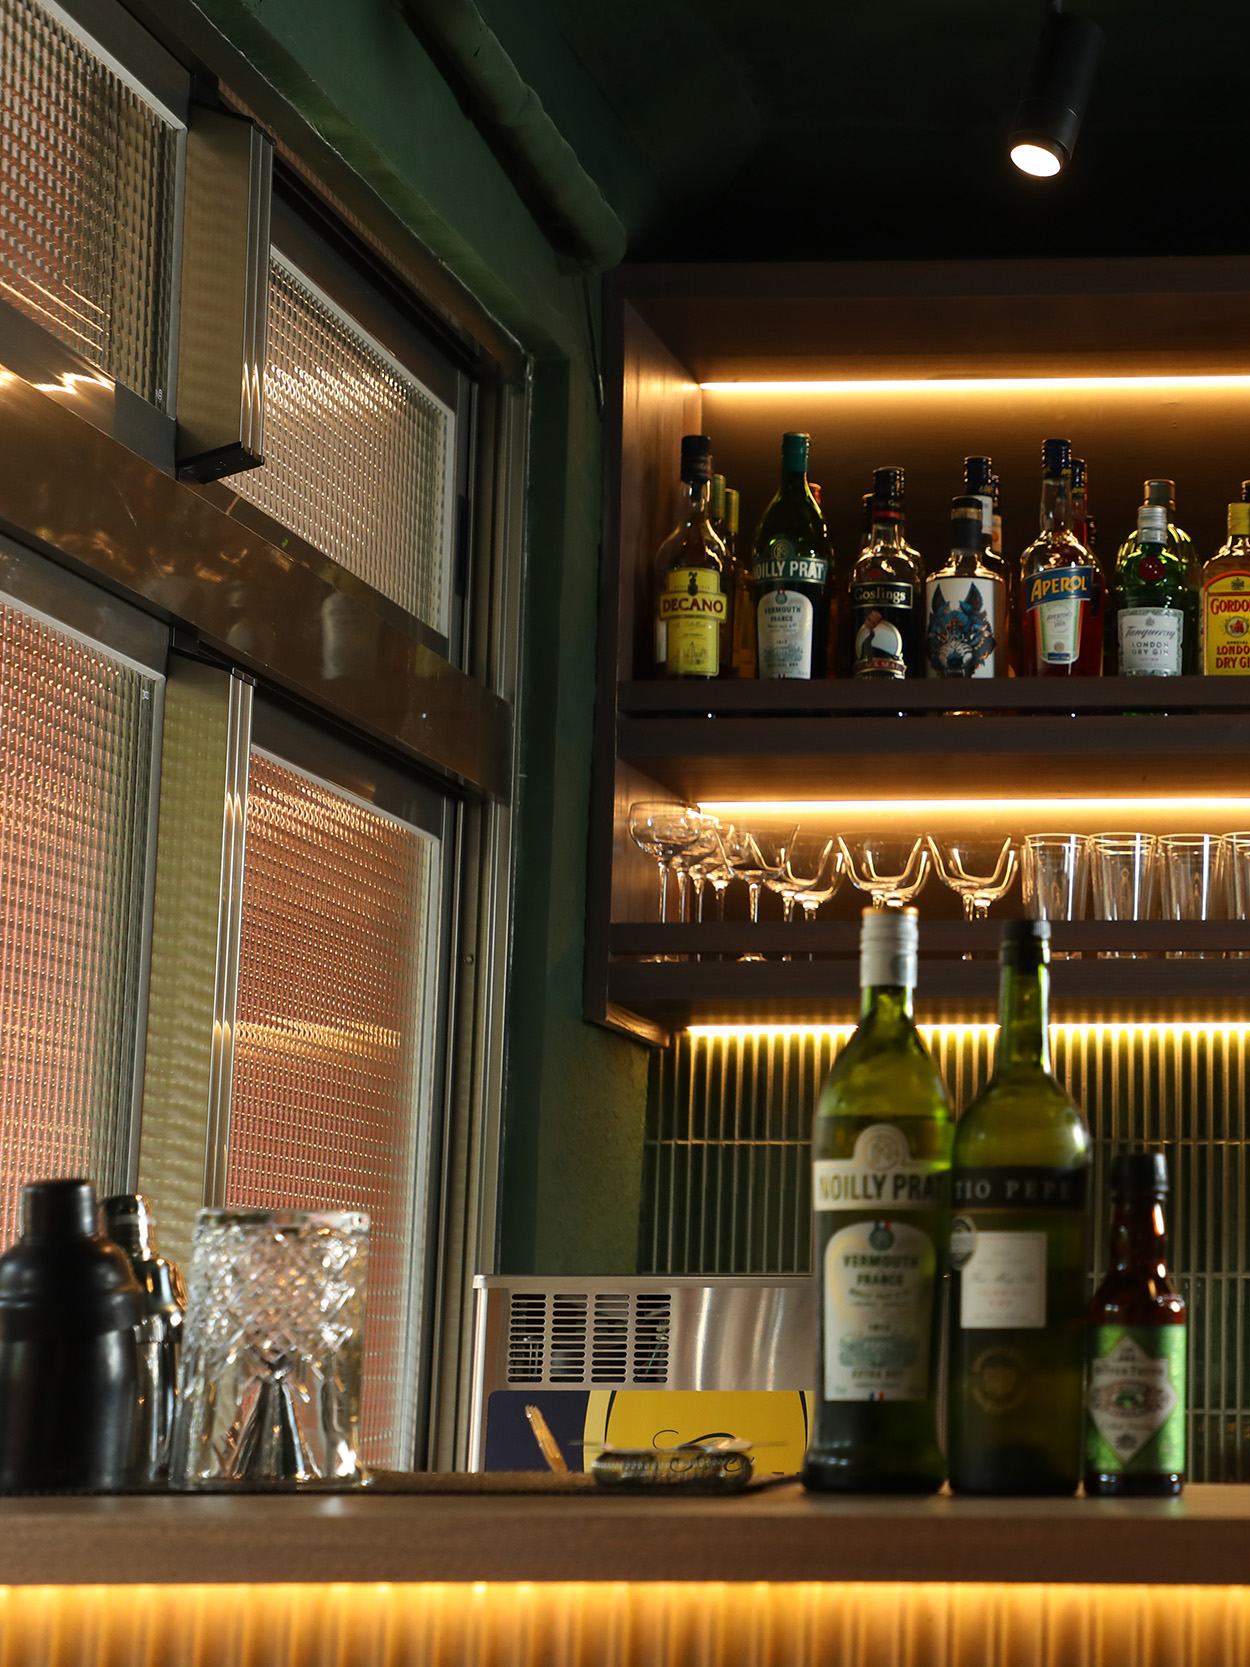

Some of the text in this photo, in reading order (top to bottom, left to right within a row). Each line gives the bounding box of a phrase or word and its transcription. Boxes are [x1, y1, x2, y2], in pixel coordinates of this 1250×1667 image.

[754, 560, 825, 580] OILLY PRAT
[854, 586, 907, 605] Goslings
[1030, 575, 1087, 602] APEROL
[662, 598, 724, 614] DECANO
[764, 606, 801, 615] VERMOUTH
[1124, 625, 1176, 640] Tanqueray
[1132, 641, 1169, 649] LONDON
[1132, 648, 1169, 656] DRY GIN
[1215, 657, 1238, 669] DRY
[820, 1173, 887, 1200] NOILLY
[955, 1179, 992, 1200] TIO
[842, 1254, 920, 1268] VERMOUTH
[857, 1273, 904, 1286] FRANCE
